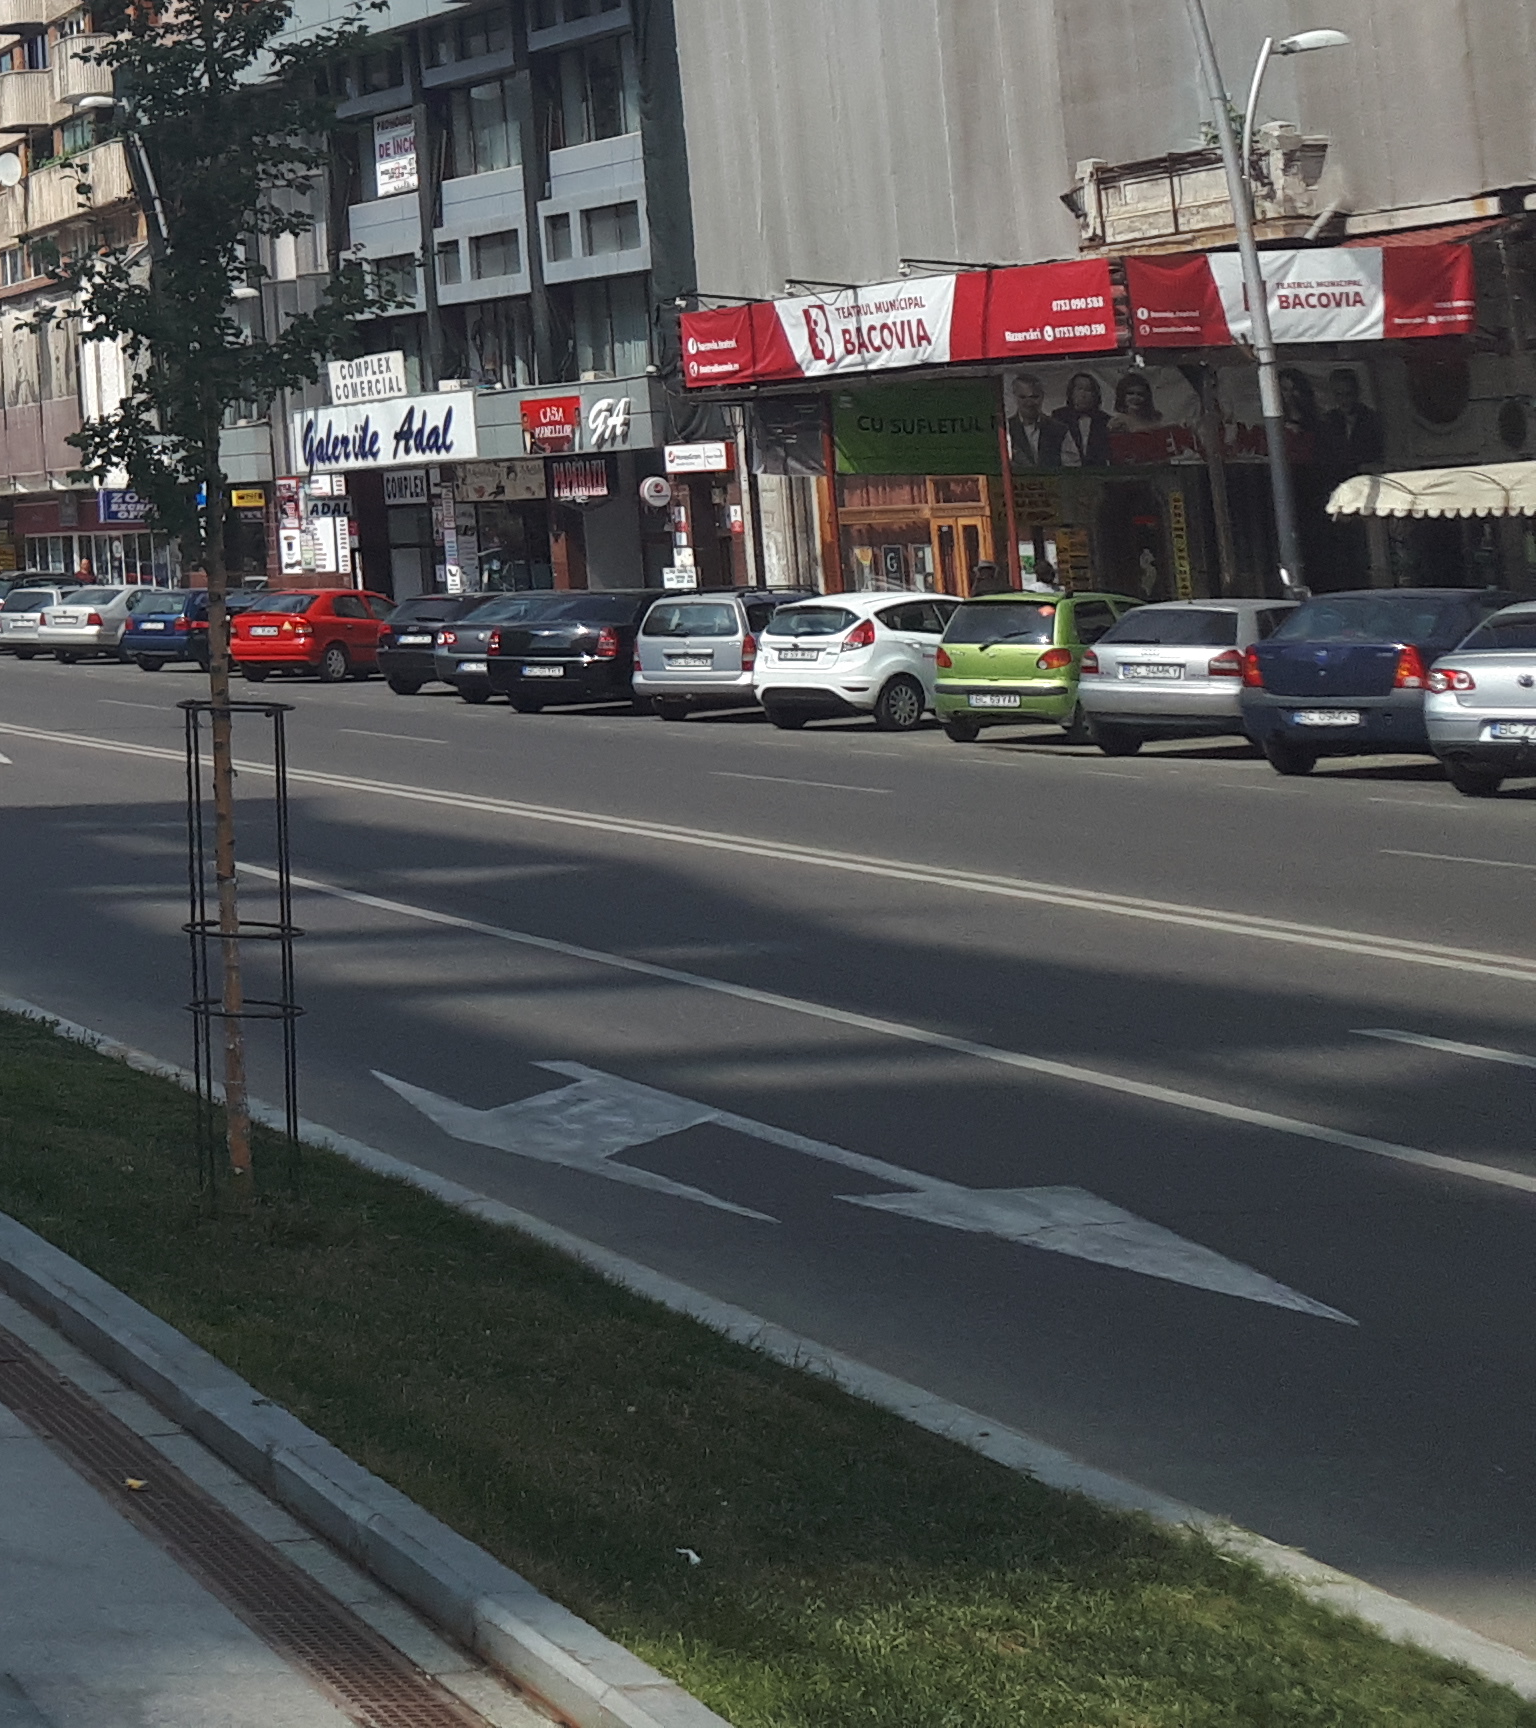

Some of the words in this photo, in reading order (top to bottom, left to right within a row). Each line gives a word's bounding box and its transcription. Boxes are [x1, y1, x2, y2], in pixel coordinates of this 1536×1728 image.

[835, 302, 873, 320] TEATRUL
[874, 295, 927, 314] MUNICIPAL
[1277, 292, 1366, 310] BACOVIA
[841, 318, 932, 356] BACOVIA
[339, 356, 392, 381] COMPLEX
[335, 375, 403, 401] COMERCIAL
[393, 405, 454, 460] Adal
[857, 415, 884, 433] CU
[891, 415, 985, 434] SUFLETUL
[385, 475, 425, 500] COMPLEX
[310, 502, 350, 516] ADAL
[1499, 723, 1520, 735] BC
